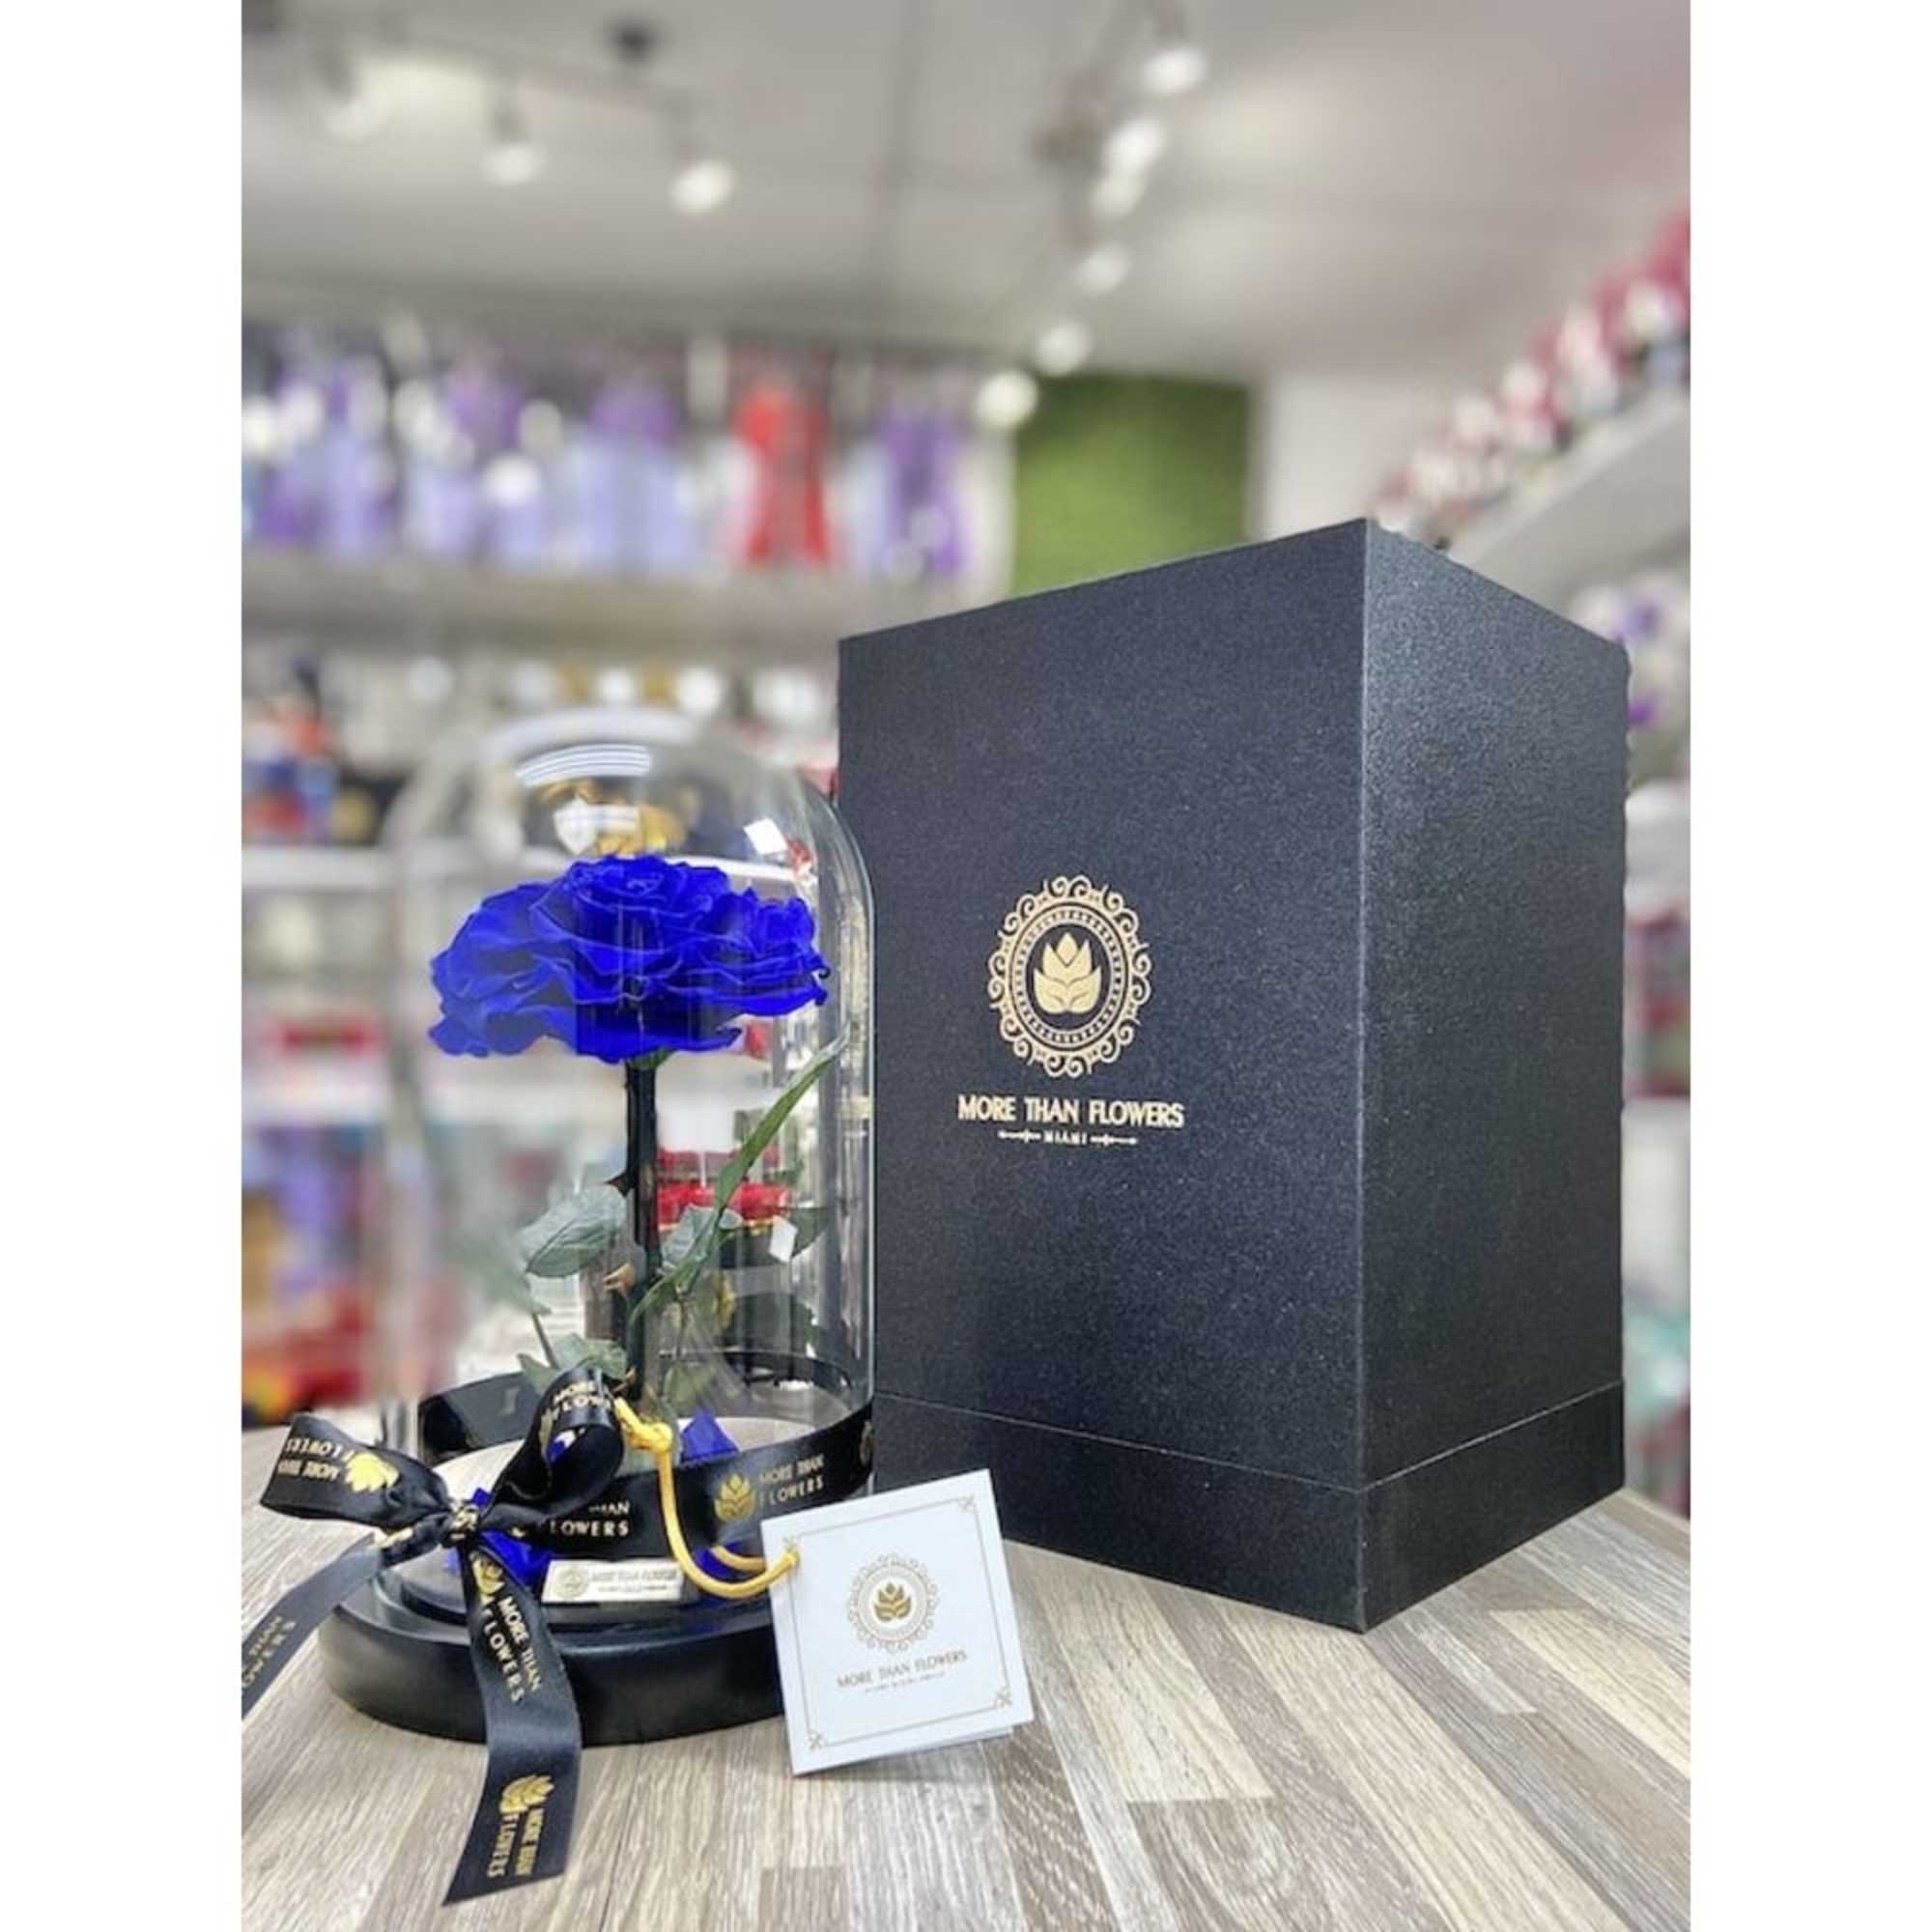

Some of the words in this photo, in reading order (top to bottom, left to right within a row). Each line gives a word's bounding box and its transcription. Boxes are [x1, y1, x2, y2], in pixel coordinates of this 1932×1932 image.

[957, 1094, 1016, 1122] MORE
[1024, 1095, 1079, 1125] THAN
[1089, 1098, 1185, 1128] FLOWERS
[1043, 1129, 1088, 1145] MIAMI
[759, 1463, 793, 1484] MORE
[795, 1452, 825, 1473] THAN
[497, 1595, 531, 1644] MORE
[522, 1646, 543, 1692] THAN
[836, 1670, 873, 1687] MORE
[878, 1662, 911, 1679] THAN
[914, 1648, 967, 1672] FLOWERS
